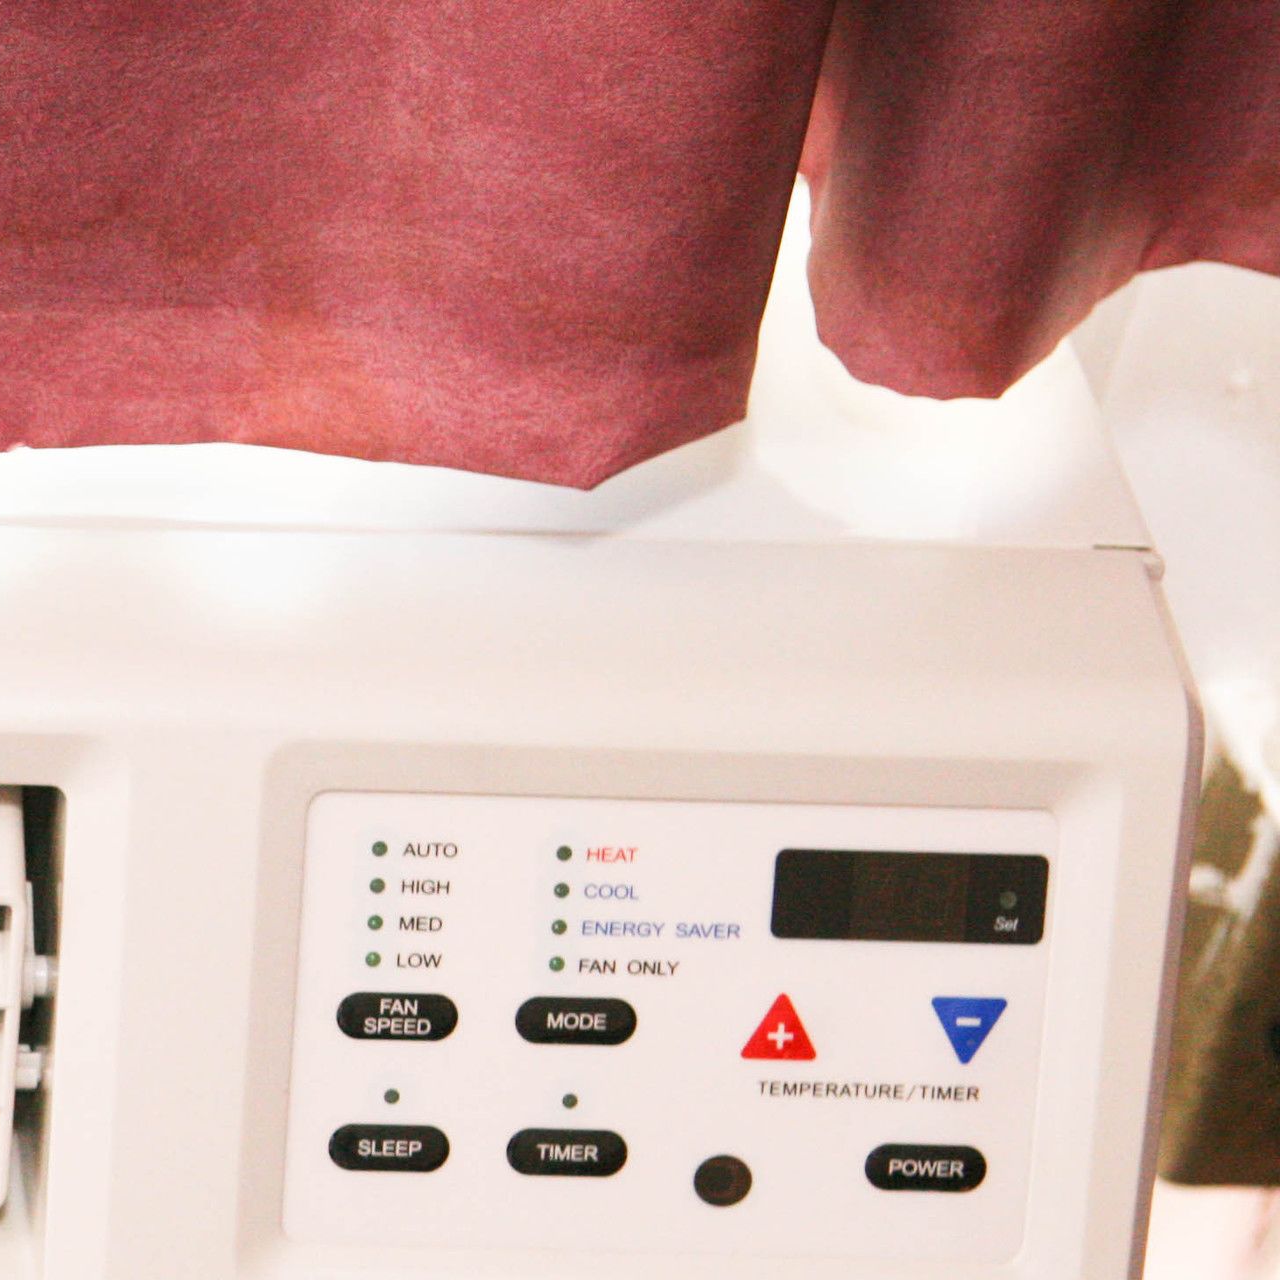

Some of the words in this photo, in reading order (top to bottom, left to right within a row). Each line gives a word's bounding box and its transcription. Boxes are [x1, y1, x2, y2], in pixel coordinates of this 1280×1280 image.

[402, 842, 458, 859] AUTO
[586, 846, 639, 864] HEAT
[401, 879, 451, 896] HIGH
[583, 883, 639, 901] COOL
[399, 915, 443, 932] MED
[581, 919, 665, 938] ENERGY
[675, 922, 742, 940] SAVER
[396, 952, 443, 969] LOW
[578, 958, 617, 975] FAN
[626, 959, 681, 977] ONLY
[378, 998, 419, 1017] FAN
[363, 1017, 432, 1036] SPEED
[546, 1011, 607, 1031] MODE
[357, 1138, 423, 1158] SLEEP
[536, 1143, 599, 1163] TIMER
[888, 1158, 965, 1178] POWER
